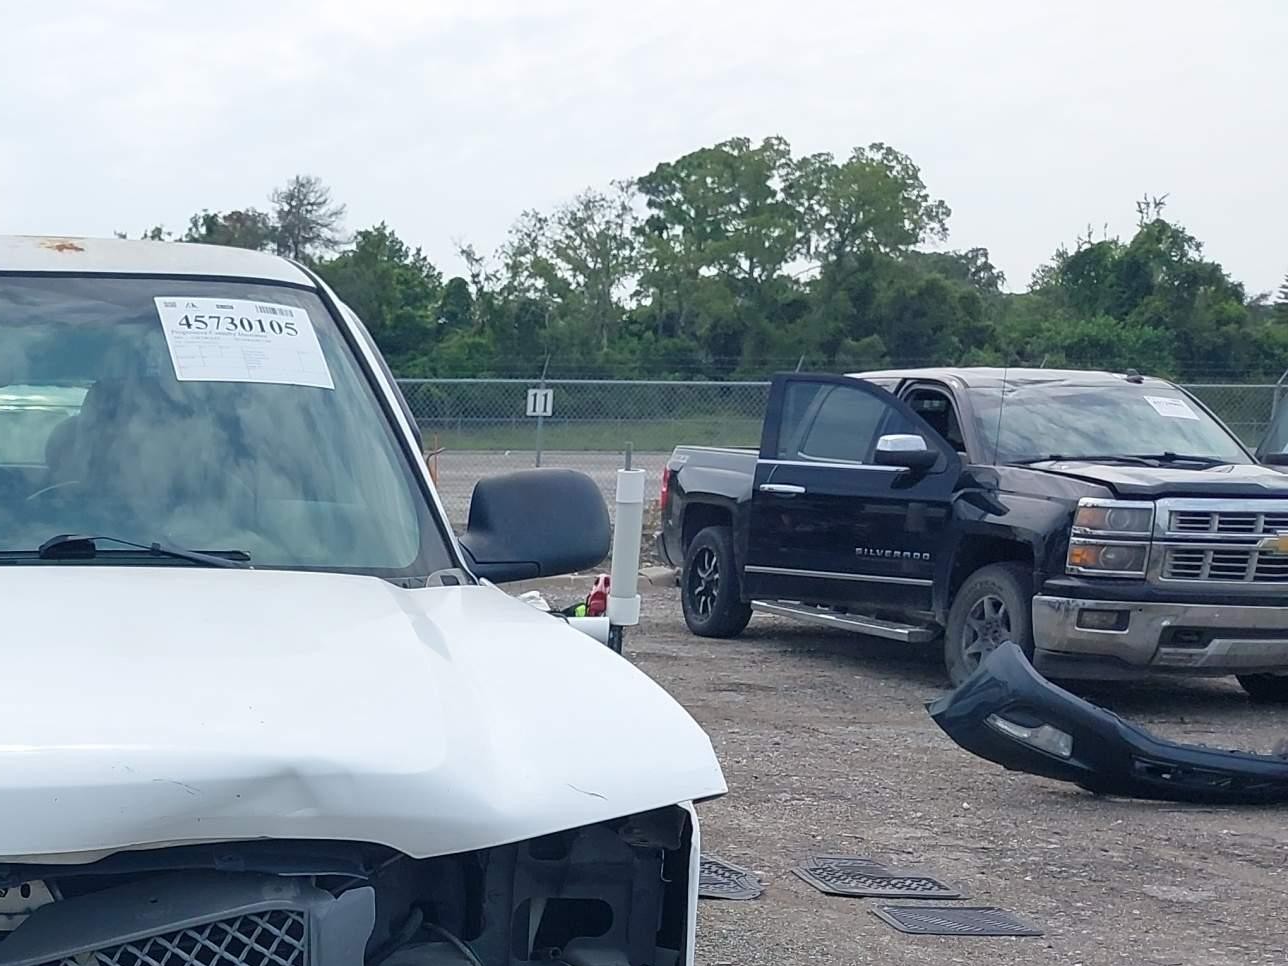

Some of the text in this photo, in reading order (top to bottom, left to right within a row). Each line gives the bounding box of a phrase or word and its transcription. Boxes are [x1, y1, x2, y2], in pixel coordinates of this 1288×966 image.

[178, 314, 299, 337] 45730105
[532, 392, 549, 413] 11
[855, 547, 930, 560] SILVERADO
